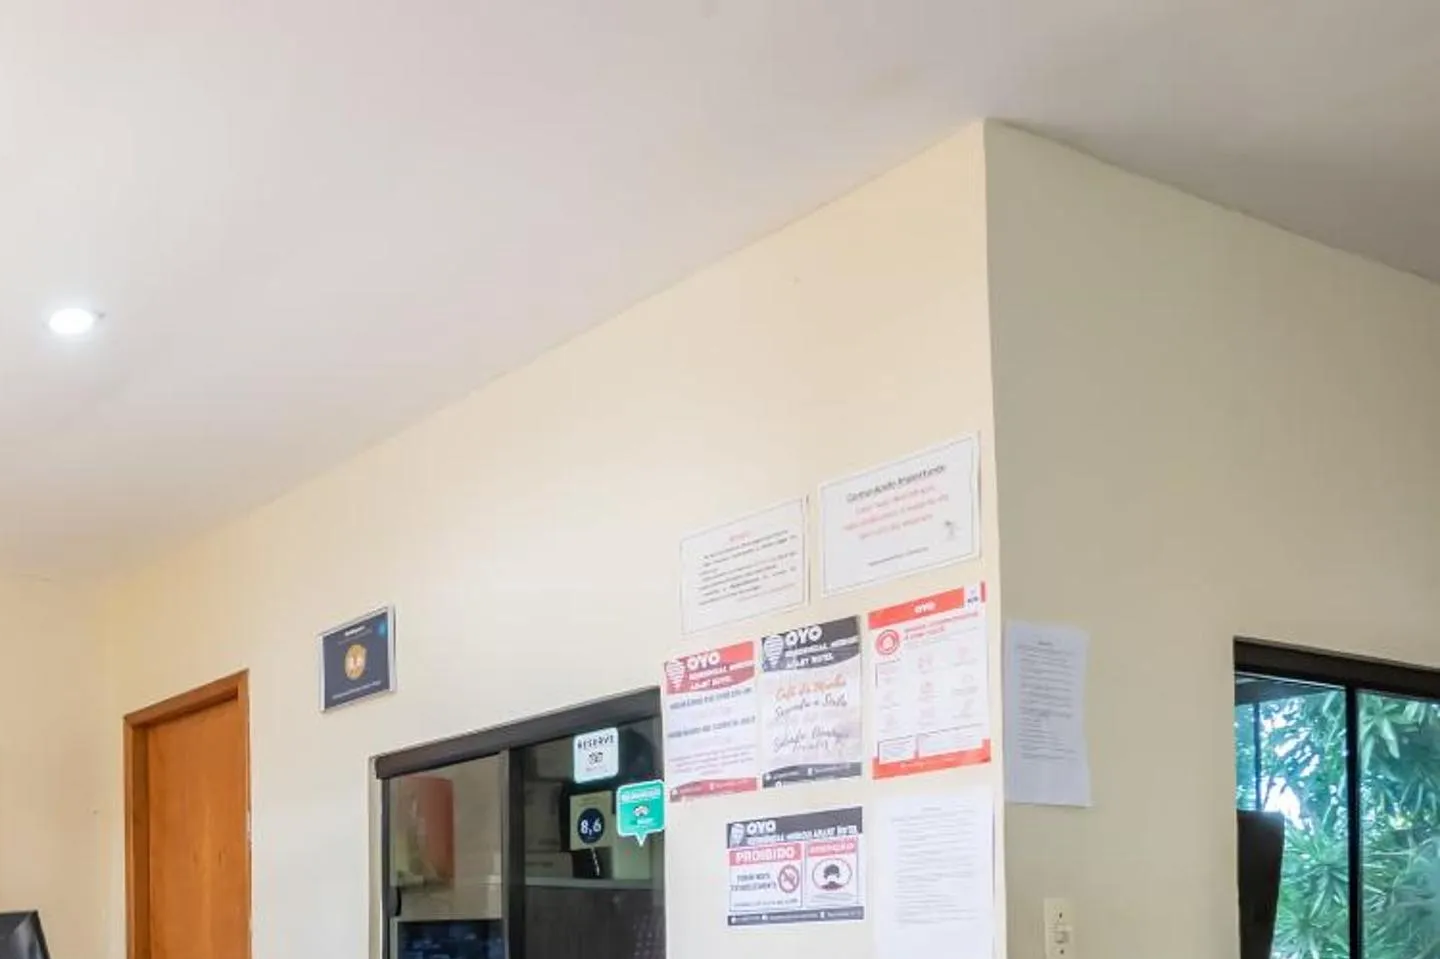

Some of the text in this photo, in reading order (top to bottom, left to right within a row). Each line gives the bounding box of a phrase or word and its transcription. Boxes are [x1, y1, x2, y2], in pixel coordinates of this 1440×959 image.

[785, 626, 822, 646] OYO
[687, 651, 720, 670] OYO
[577, 735, 615, 749] RESERVE
[580, 818, 602, 835] 8,6
[747, 820, 776, 835] OYO
[735, 846, 796, 864] PROIBIDO
